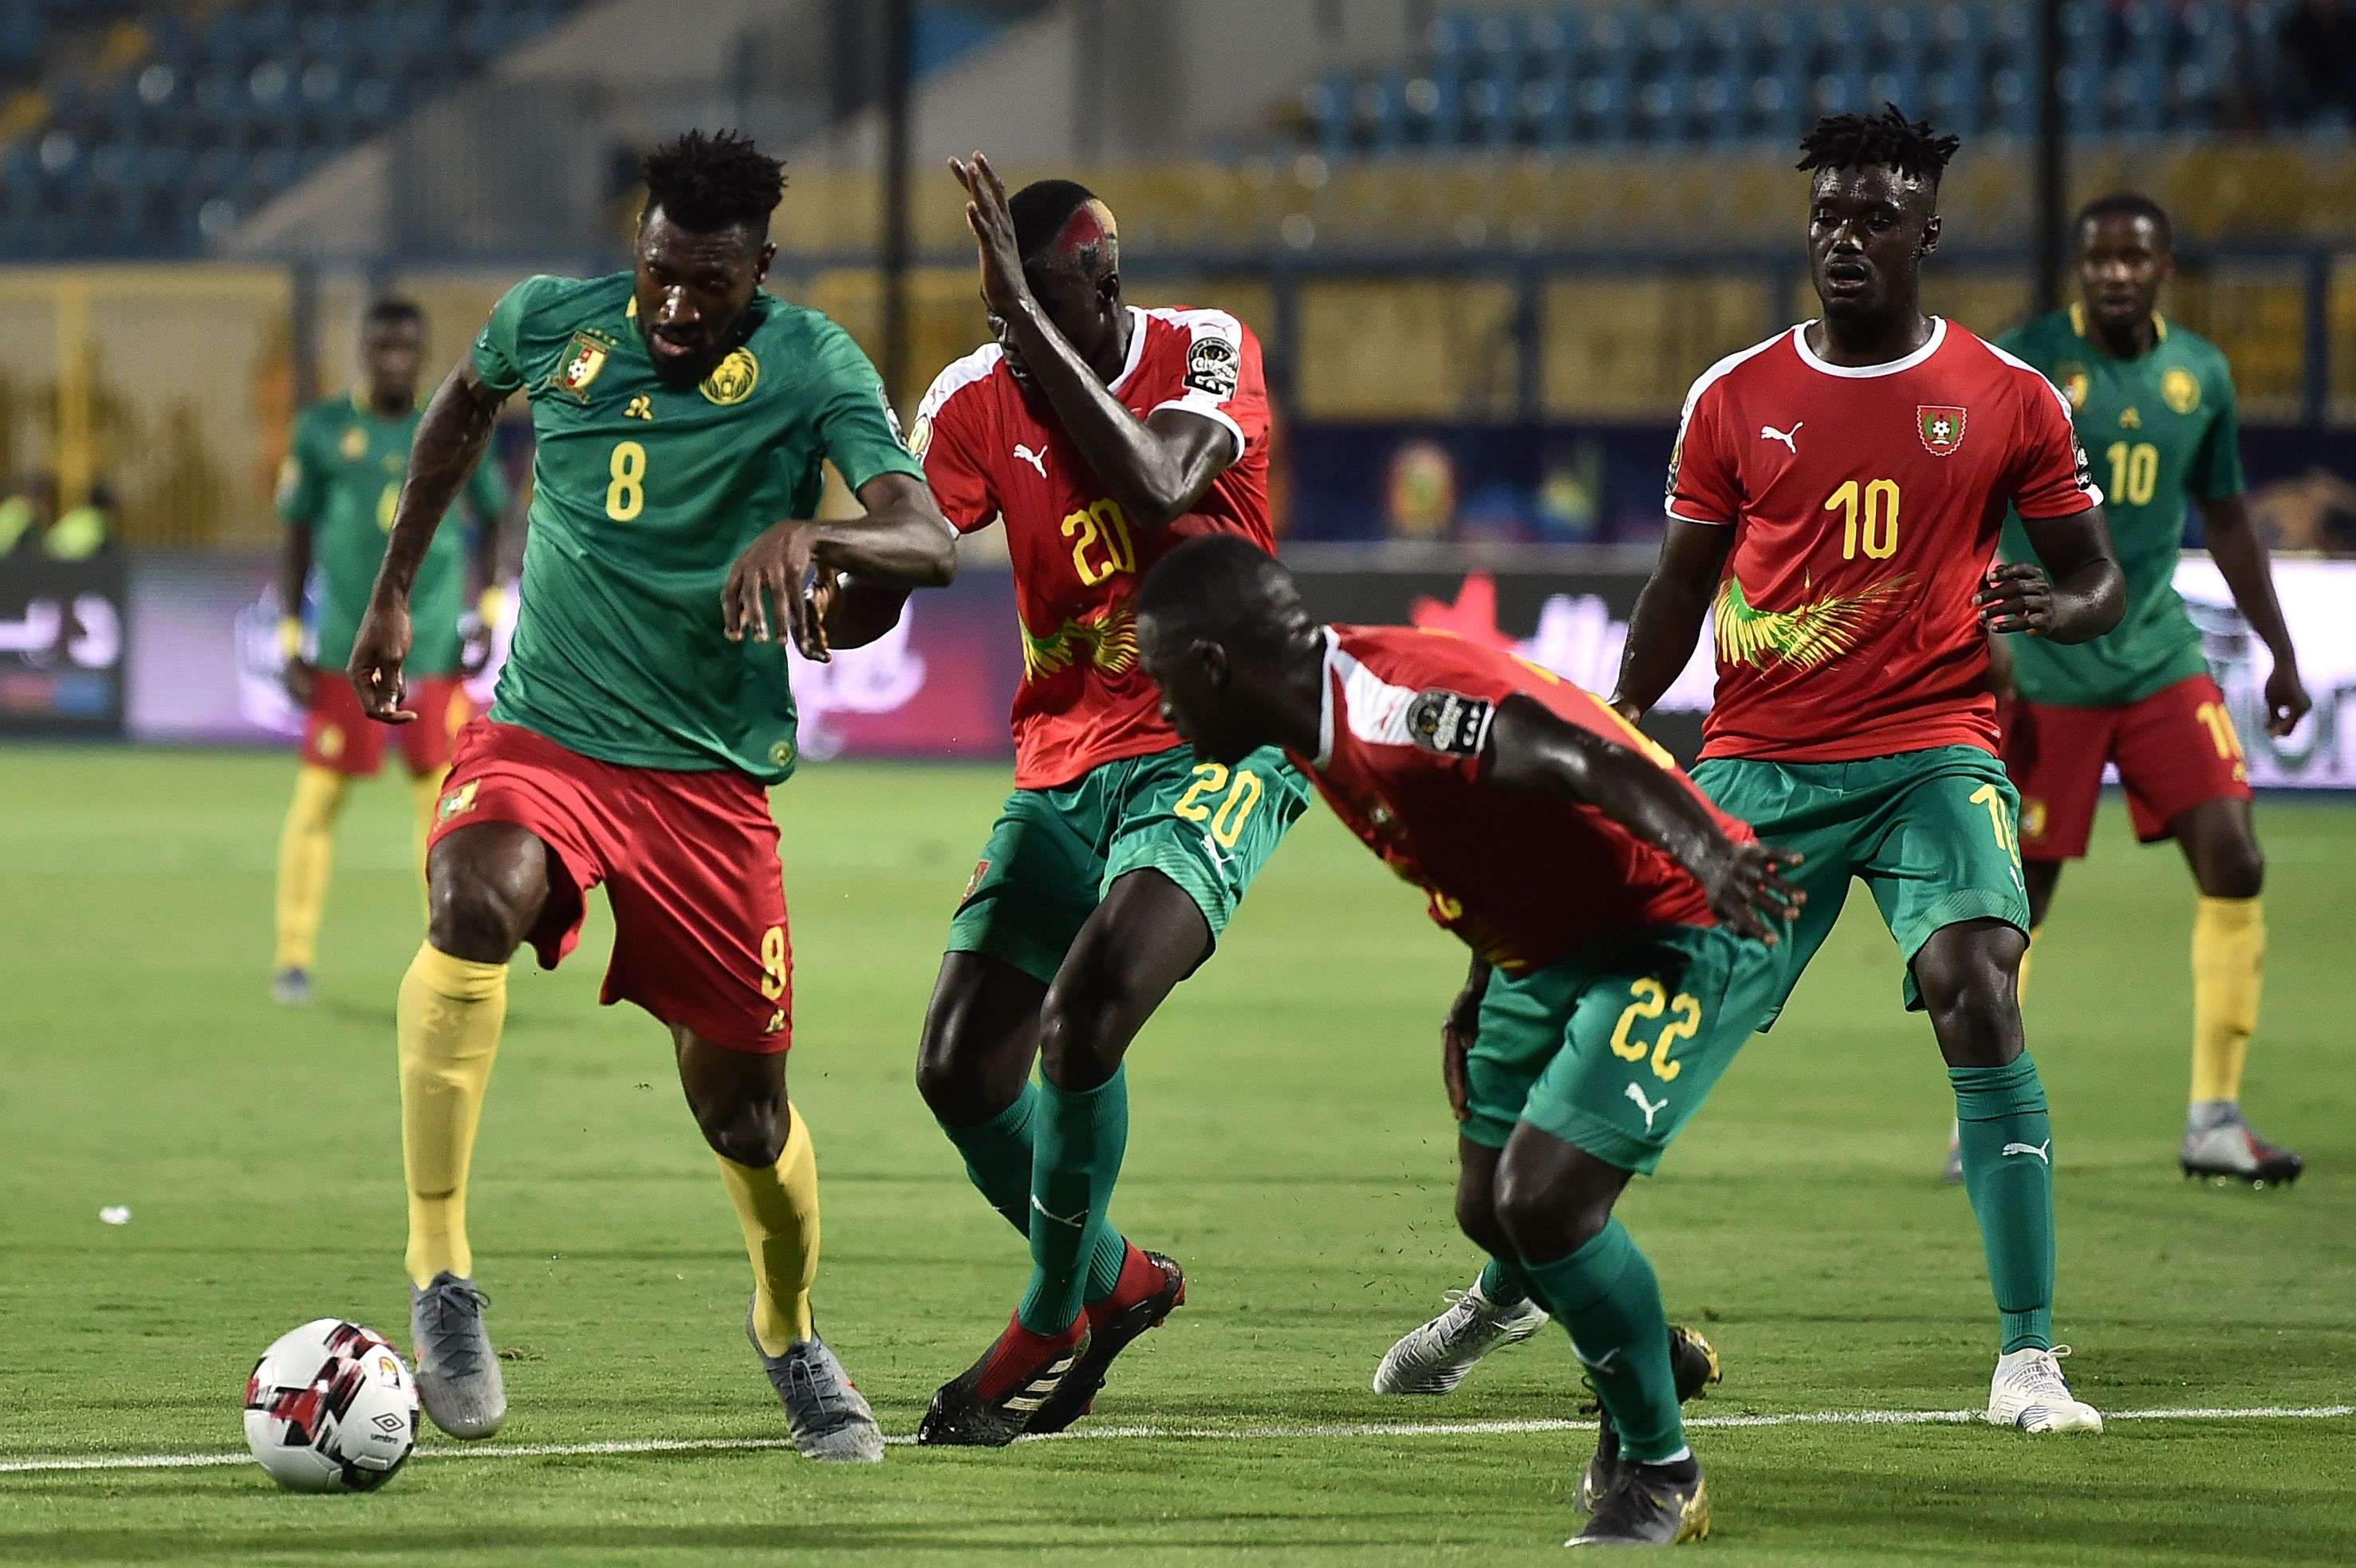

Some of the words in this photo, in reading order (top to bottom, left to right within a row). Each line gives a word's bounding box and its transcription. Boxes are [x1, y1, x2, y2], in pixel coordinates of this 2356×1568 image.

[605, 442, 646, 522] 8
[2106, 440, 2159, 506] 10
[1060, 498, 1137, 587] 20
[1824, 479, 1901, 561] 10
[1173, 762, 1262, 848] 20
[761, 925, 786, 1001] 8
[1609, 977, 1701, 1081] 22
